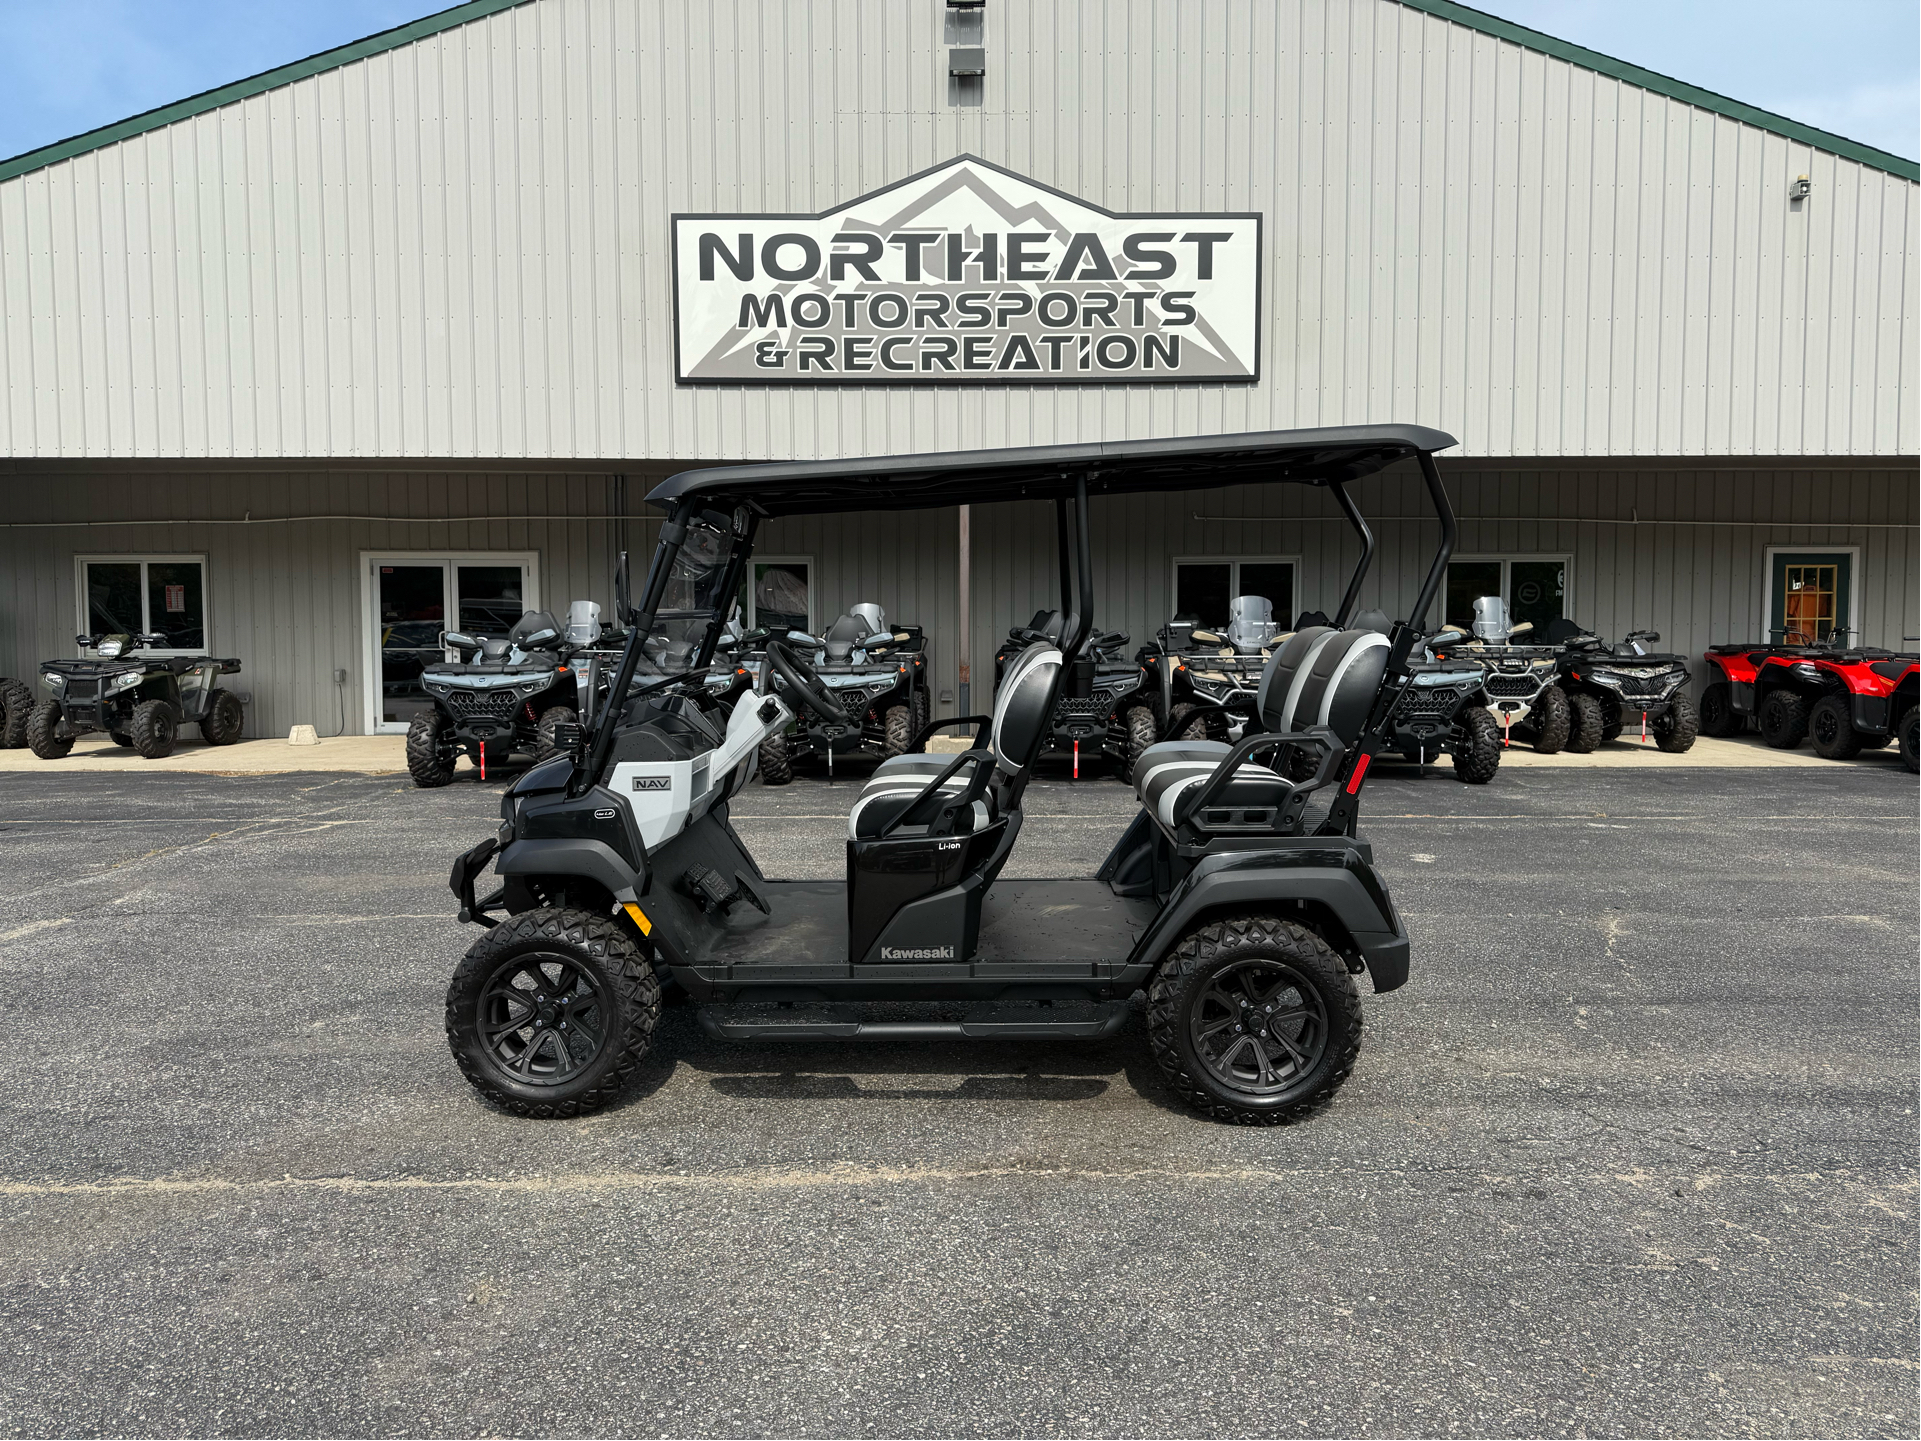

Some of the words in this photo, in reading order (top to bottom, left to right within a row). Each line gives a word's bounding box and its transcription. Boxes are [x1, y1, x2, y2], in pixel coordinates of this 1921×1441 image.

[699, 232, 1234, 282] NORTHEAST
[738, 291, 1197, 329] MOTORSPORTS
[635, 779, 669, 789] NAV
[881, 946, 954, 959] Kawasaki
